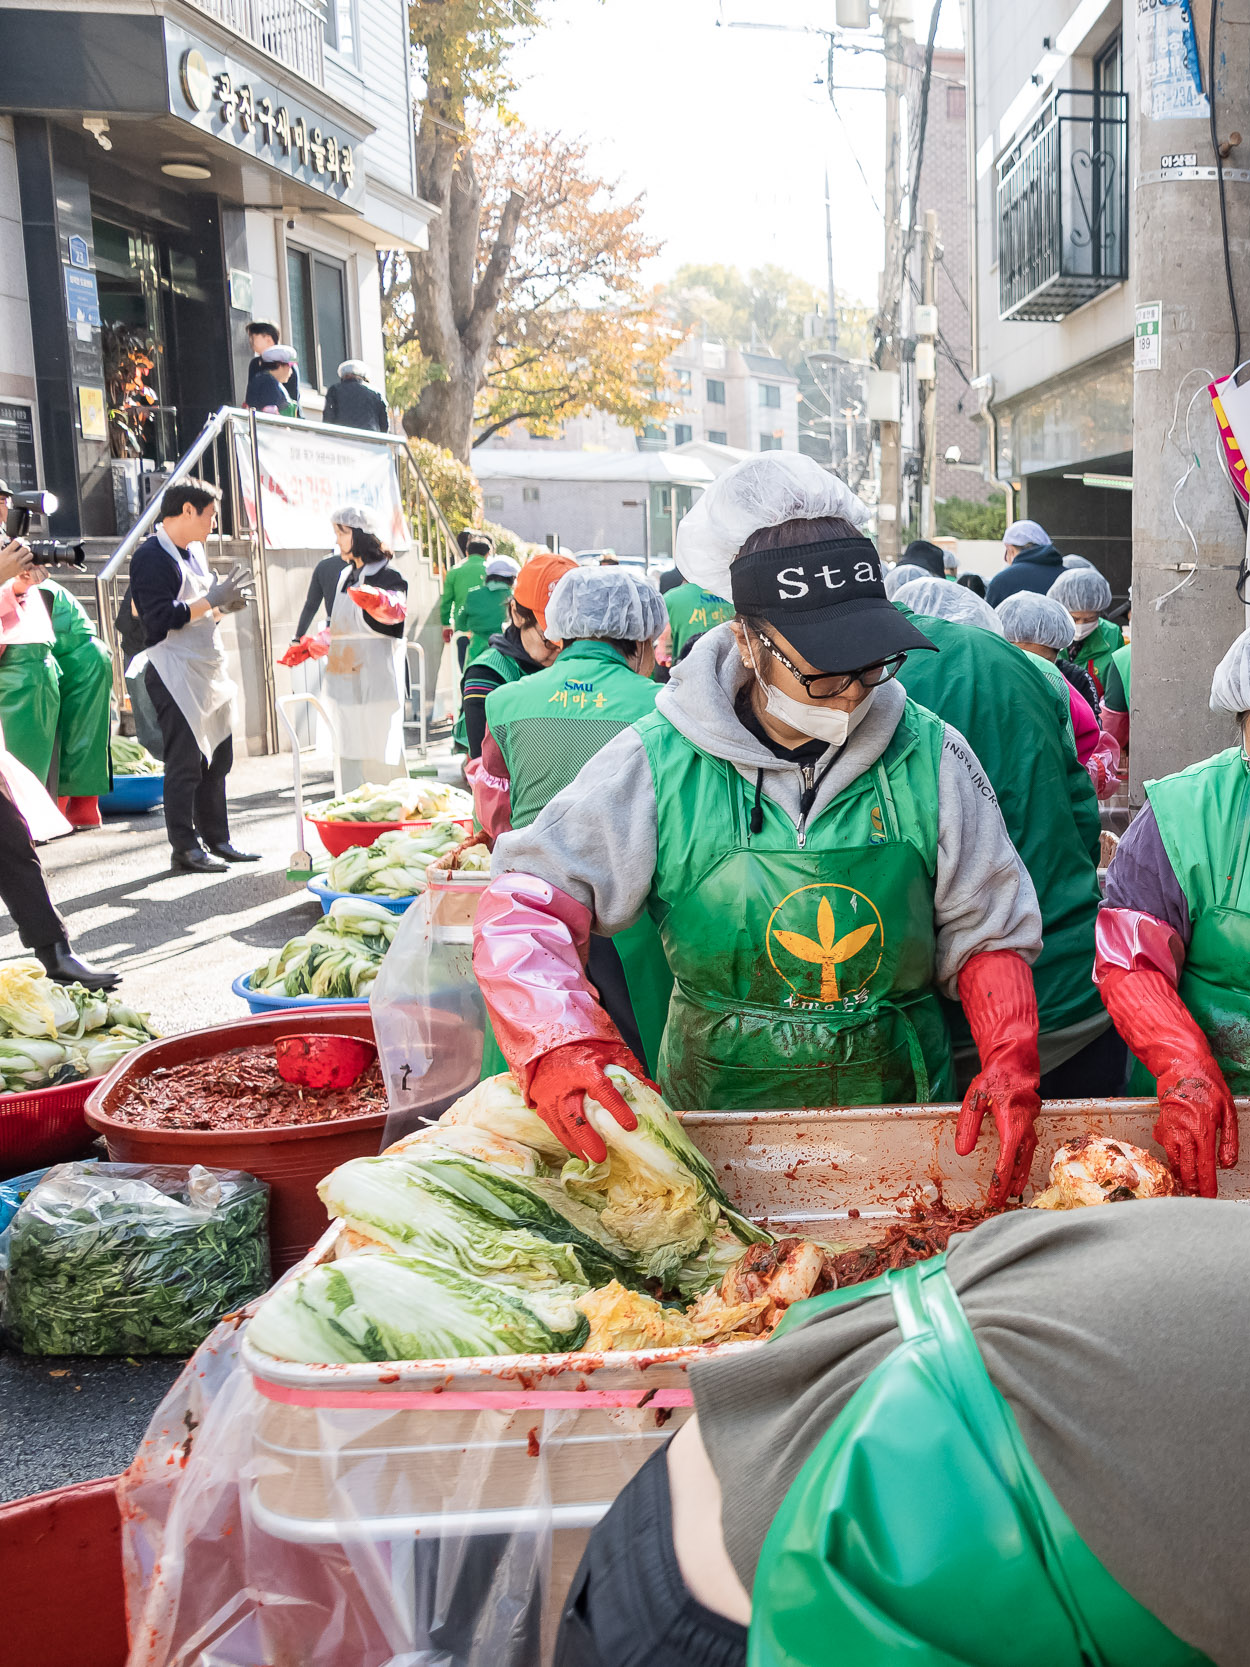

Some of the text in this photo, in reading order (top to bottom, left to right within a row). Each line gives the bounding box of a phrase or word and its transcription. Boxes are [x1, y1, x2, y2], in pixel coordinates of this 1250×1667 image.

[216, 73, 355, 189] 광진구새마을회관
[777, 562, 884, 599] Sta
[548, 690, 607, 709] 새마을
[564, 681, 593, 692] SMU
